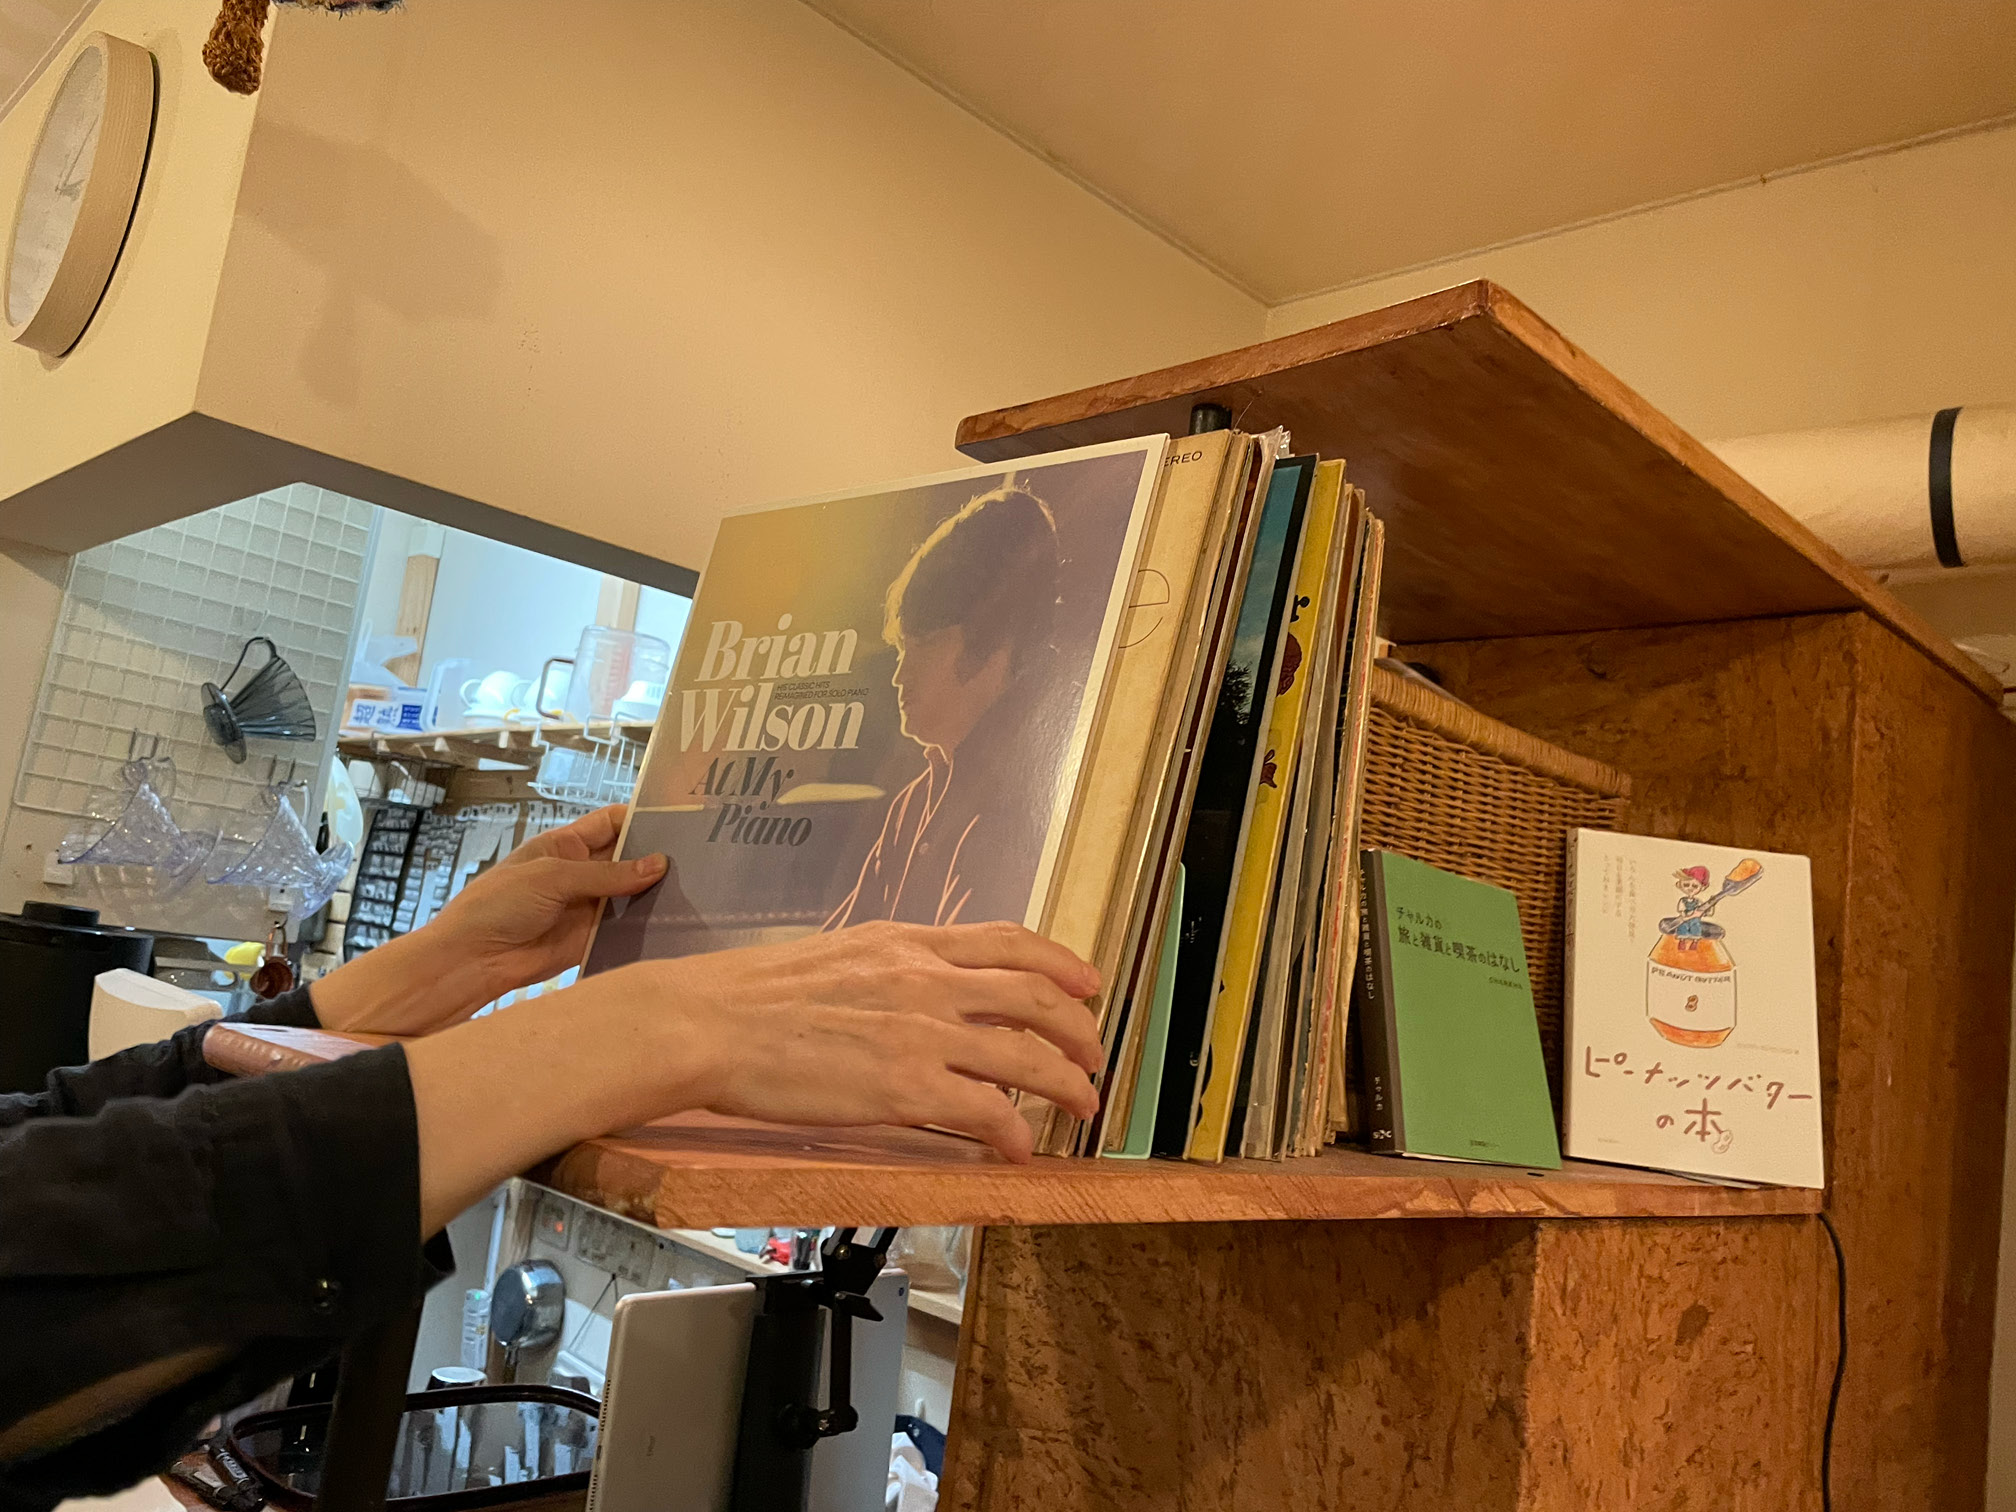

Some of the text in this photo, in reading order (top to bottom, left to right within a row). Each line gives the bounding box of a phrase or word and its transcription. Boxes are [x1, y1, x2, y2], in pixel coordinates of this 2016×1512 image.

[694, 613, 858, 682] Brian
[828, 688, 847, 698] SOLO
[680, 682, 865, 753] Wilson
[688, 756, 795, 810] At My
[706, 803, 813, 847] Piano
[1651, 966, 1693, 982] PEANUT
[1656, 1097, 1723, 1142] の本
